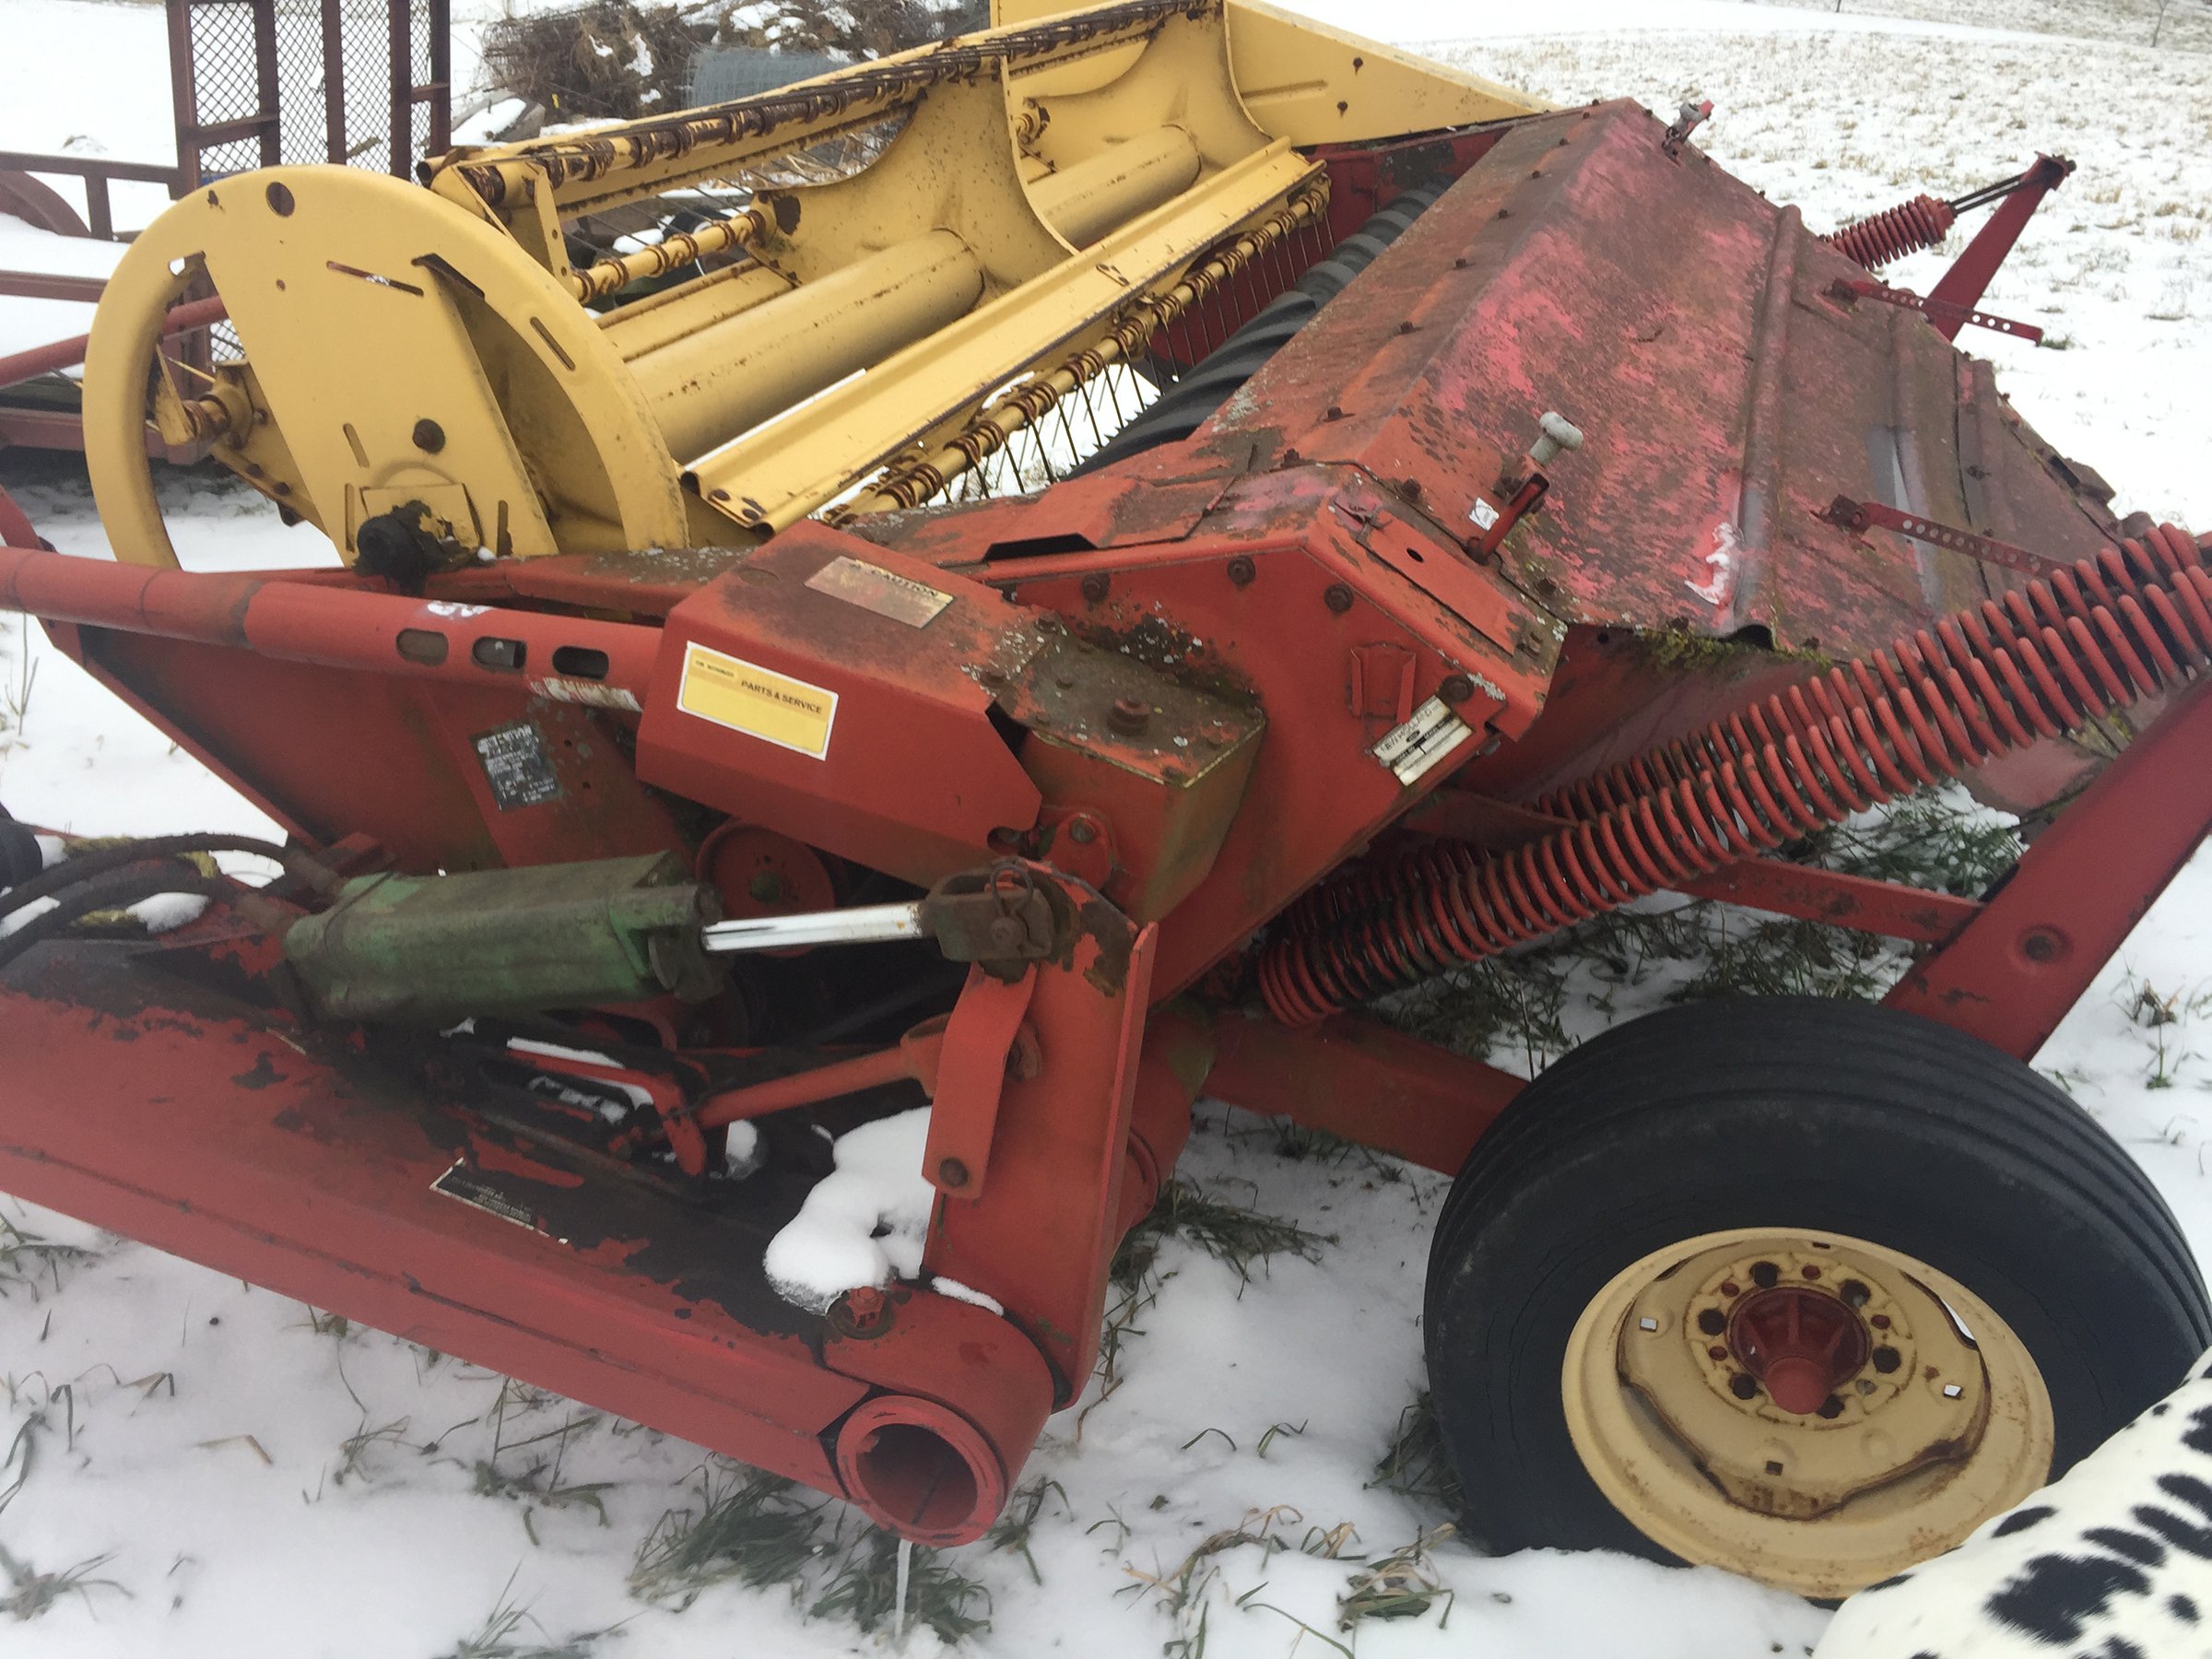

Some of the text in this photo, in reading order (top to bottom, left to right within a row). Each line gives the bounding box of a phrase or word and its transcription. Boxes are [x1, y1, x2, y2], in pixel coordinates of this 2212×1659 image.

[740, 679, 822, 714] PARTS & SERVICE
